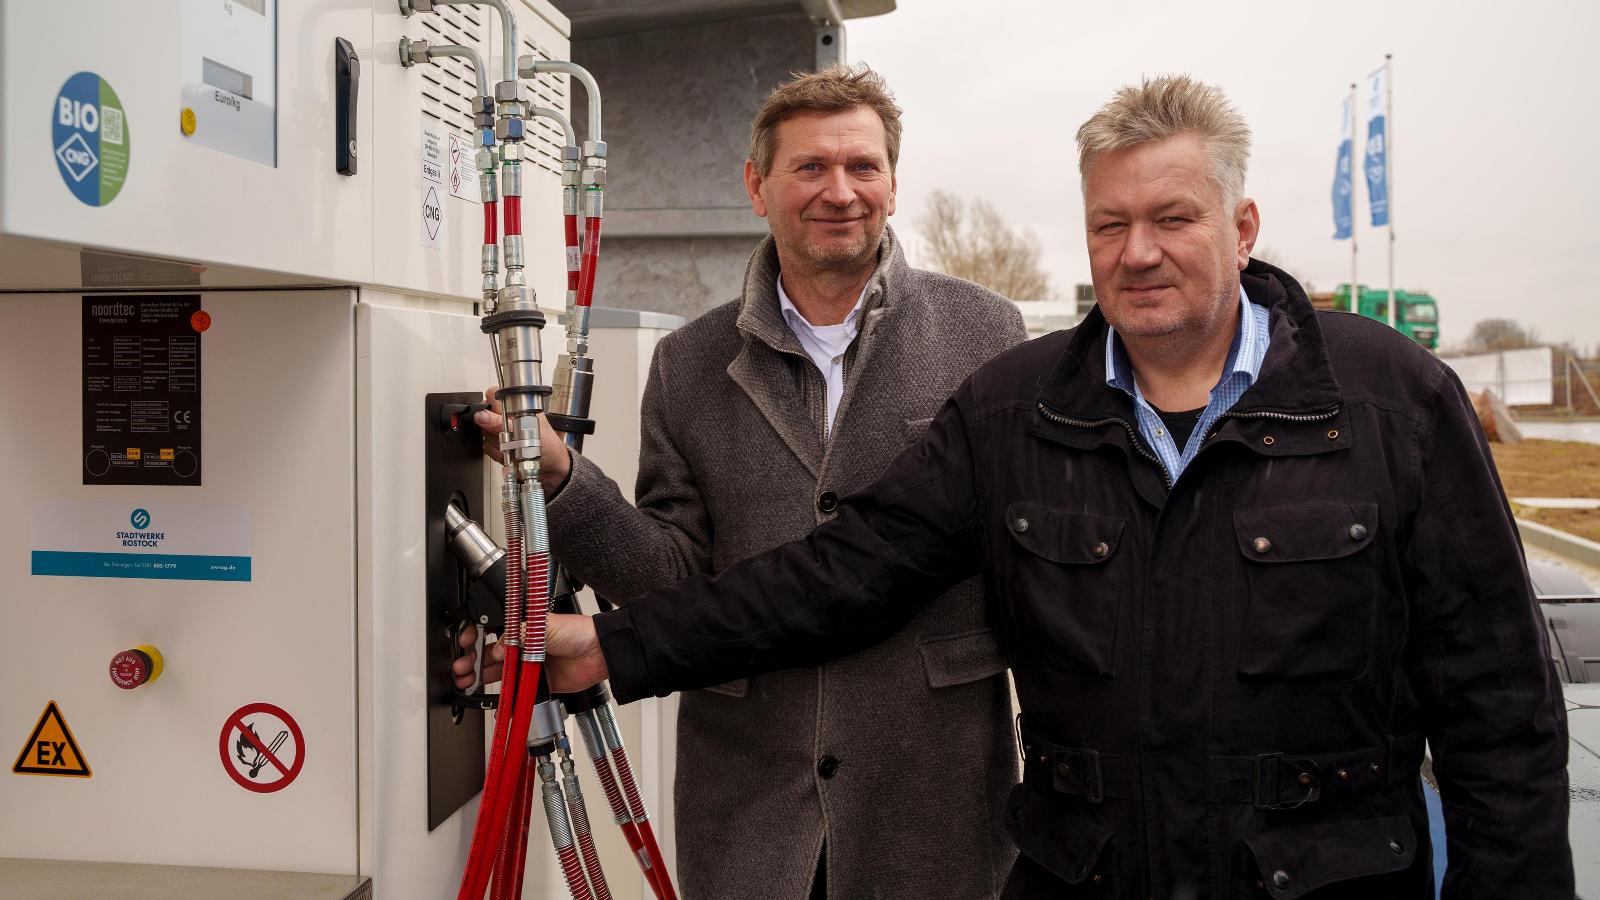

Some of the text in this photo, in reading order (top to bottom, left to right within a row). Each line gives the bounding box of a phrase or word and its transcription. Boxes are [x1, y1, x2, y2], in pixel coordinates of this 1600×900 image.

[215, 90, 241, 111] Euro/kg
[59, 96, 99, 133] BIO
[65, 148, 91, 166] CNG
[425, 204, 440, 221] CNG
[91, 302, 135, 316] noordtec
[116, 531, 165, 540] STADTWERKE
[115, 656, 125, 665] NOT
[111, 667, 134, 686] EMERGENCY
[37, 740, 66, 766] EX
